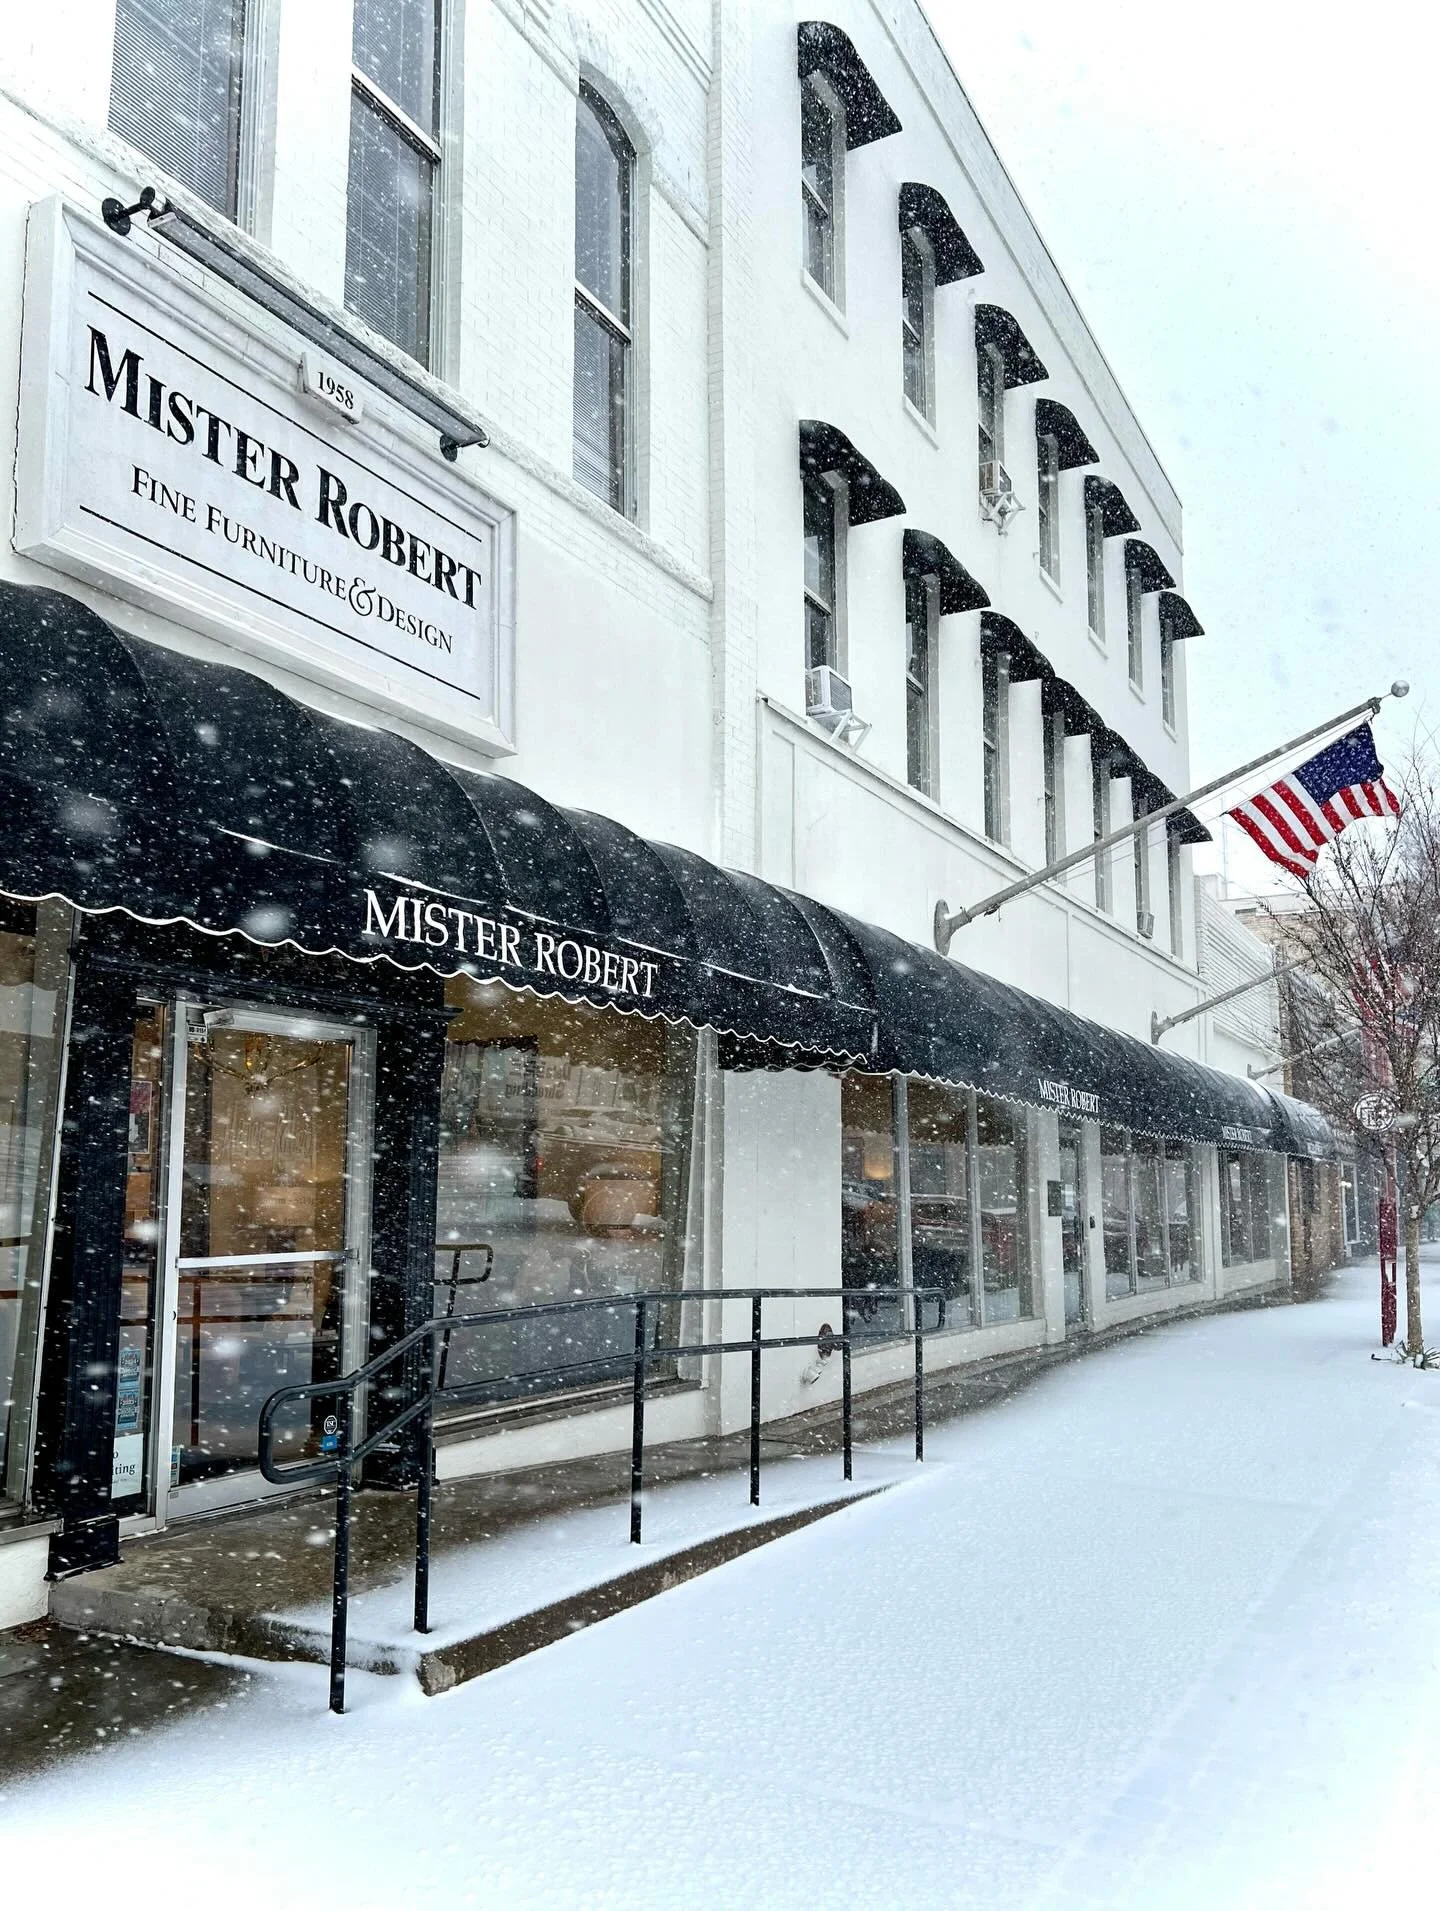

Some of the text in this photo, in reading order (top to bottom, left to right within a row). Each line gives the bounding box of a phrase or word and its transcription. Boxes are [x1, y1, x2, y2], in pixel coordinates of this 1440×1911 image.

[317, 370, 354, 410] 1958
[84, 324, 482, 610] MISTER ROBERT
[131, 464, 196, 524] FINE
[362, 888, 659, 998] MISTER ROBERT
[1038, 1078, 1100, 1113] MISTER ROBERT
[112, 1463, 136, 1476] ting
